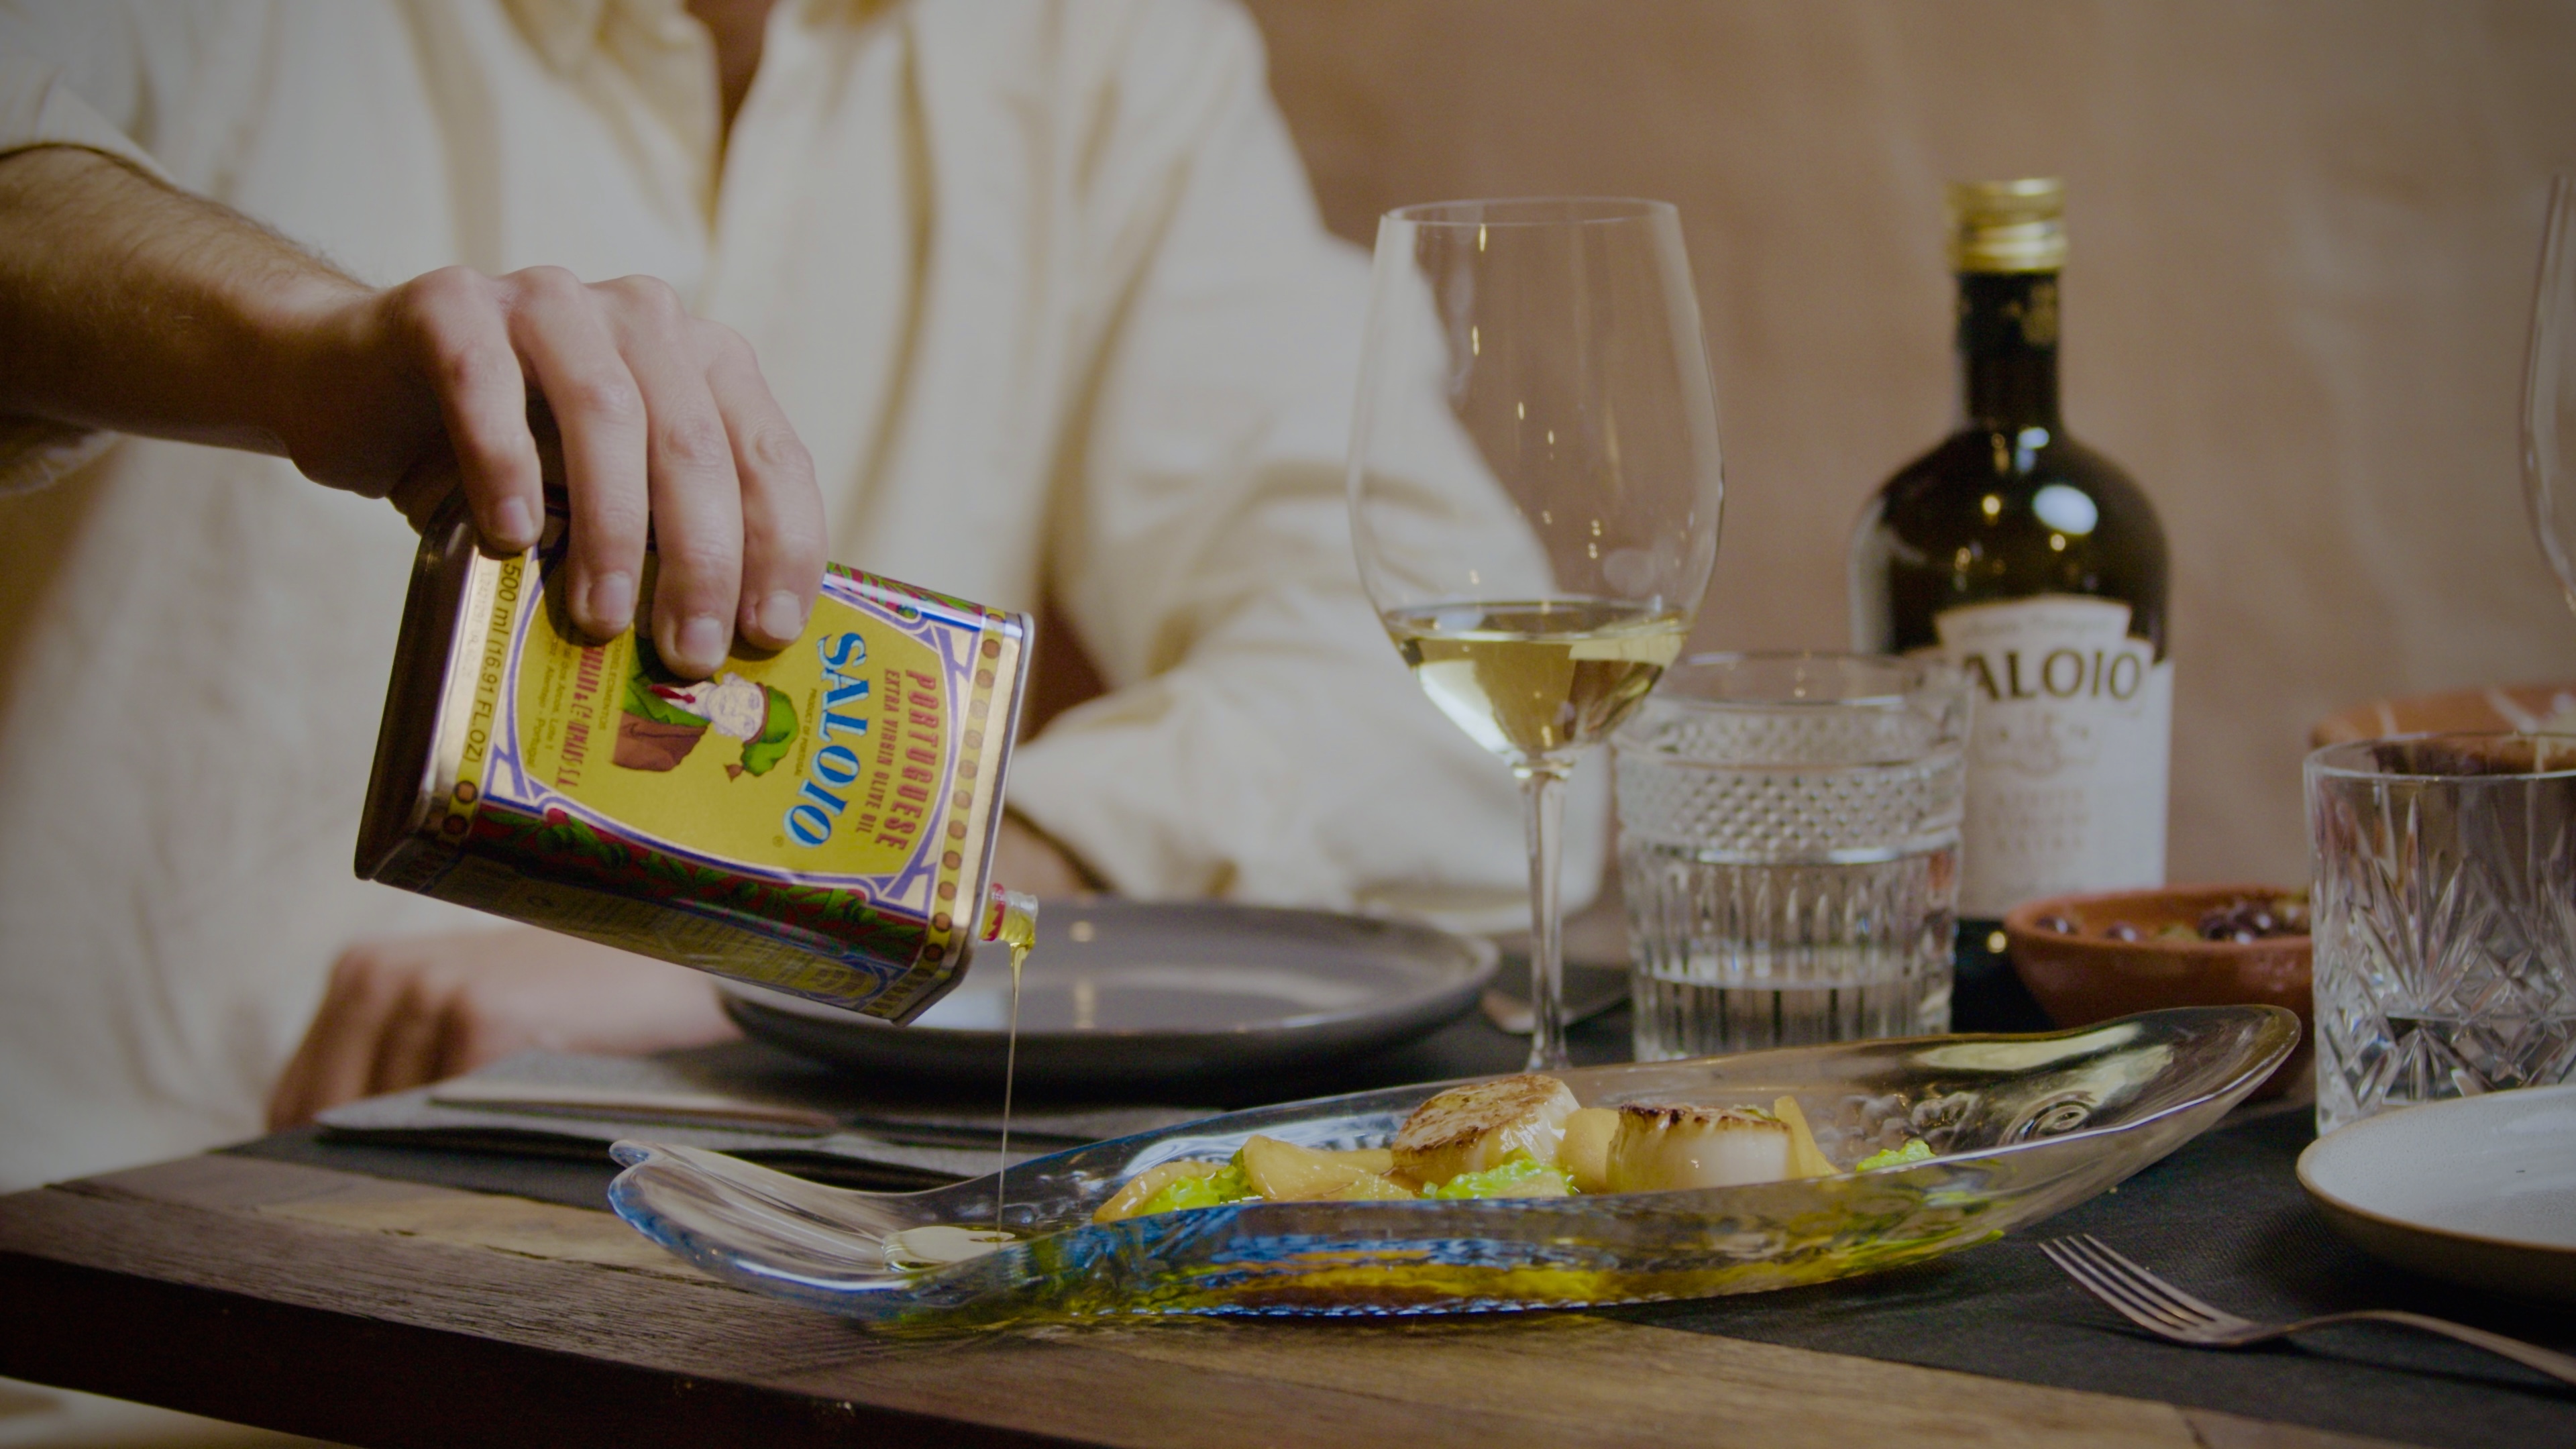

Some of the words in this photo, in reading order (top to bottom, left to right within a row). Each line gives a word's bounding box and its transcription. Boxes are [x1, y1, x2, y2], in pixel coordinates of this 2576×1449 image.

[498, 564, 520, 603] 500
[492, 607, 508, 635] ml
[479, 640, 504, 694] (16.91
[883, 668, 900, 711] EXTRA
[1962, 647, 2143, 702] ALOIO
[783, 632, 869, 847] SALOIO
[873, 669, 940, 852] PORTUGUESE
[876, 718, 897, 766] VIRGIN
[864, 770, 889, 810] OLIVE
[855, 813, 876, 833] OIL
